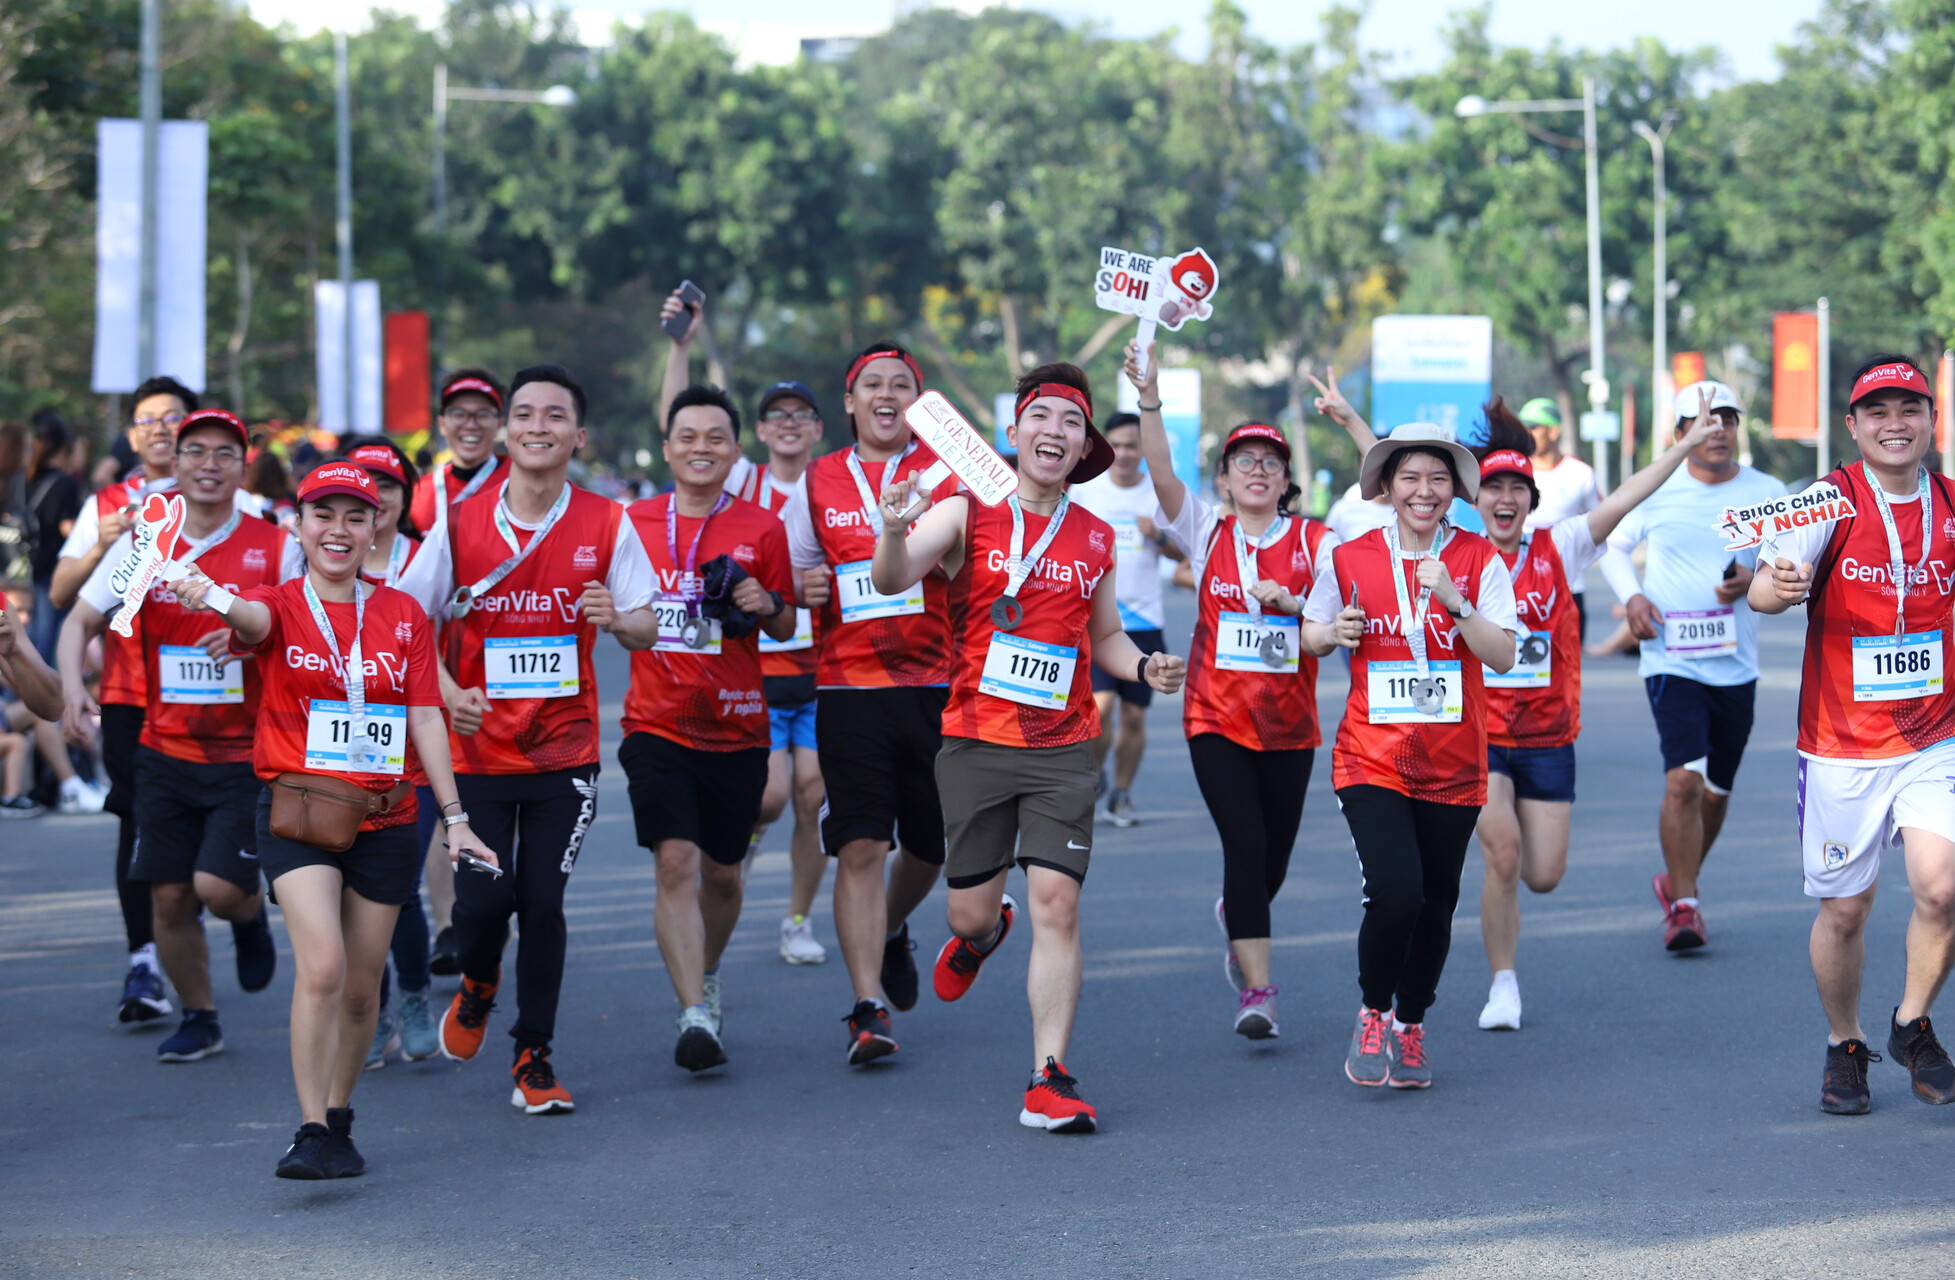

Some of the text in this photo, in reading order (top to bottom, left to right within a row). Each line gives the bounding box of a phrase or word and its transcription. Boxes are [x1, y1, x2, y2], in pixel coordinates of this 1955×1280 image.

[1104, 250, 1154, 275] WE ARE
[1098, 271, 1150, 301] SOHI
[1862, 367, 1897, 384] GenVita
[932, 429, 997, 499] VIETNAM
[943, 418, 1012, 488] GENERALI
[318, 467, 356, 479] GenVita
[1791, 489, 1839, 510] CHÂN
[1749, 499, 1854, 537] Ý NGHĨA
[111, 549, 143, 595] Chia
[1679, 621, 1726, 640] 20198
[180, 661, 226, 681] 11719
[508, 653, 561, 674] 11712
[1010, 654, 1060, 683] 11718
[1873, 649, 1931, 675] 11686
[331, 719, 392, 747] 1199
[560, 798, 594, 874] adidas
